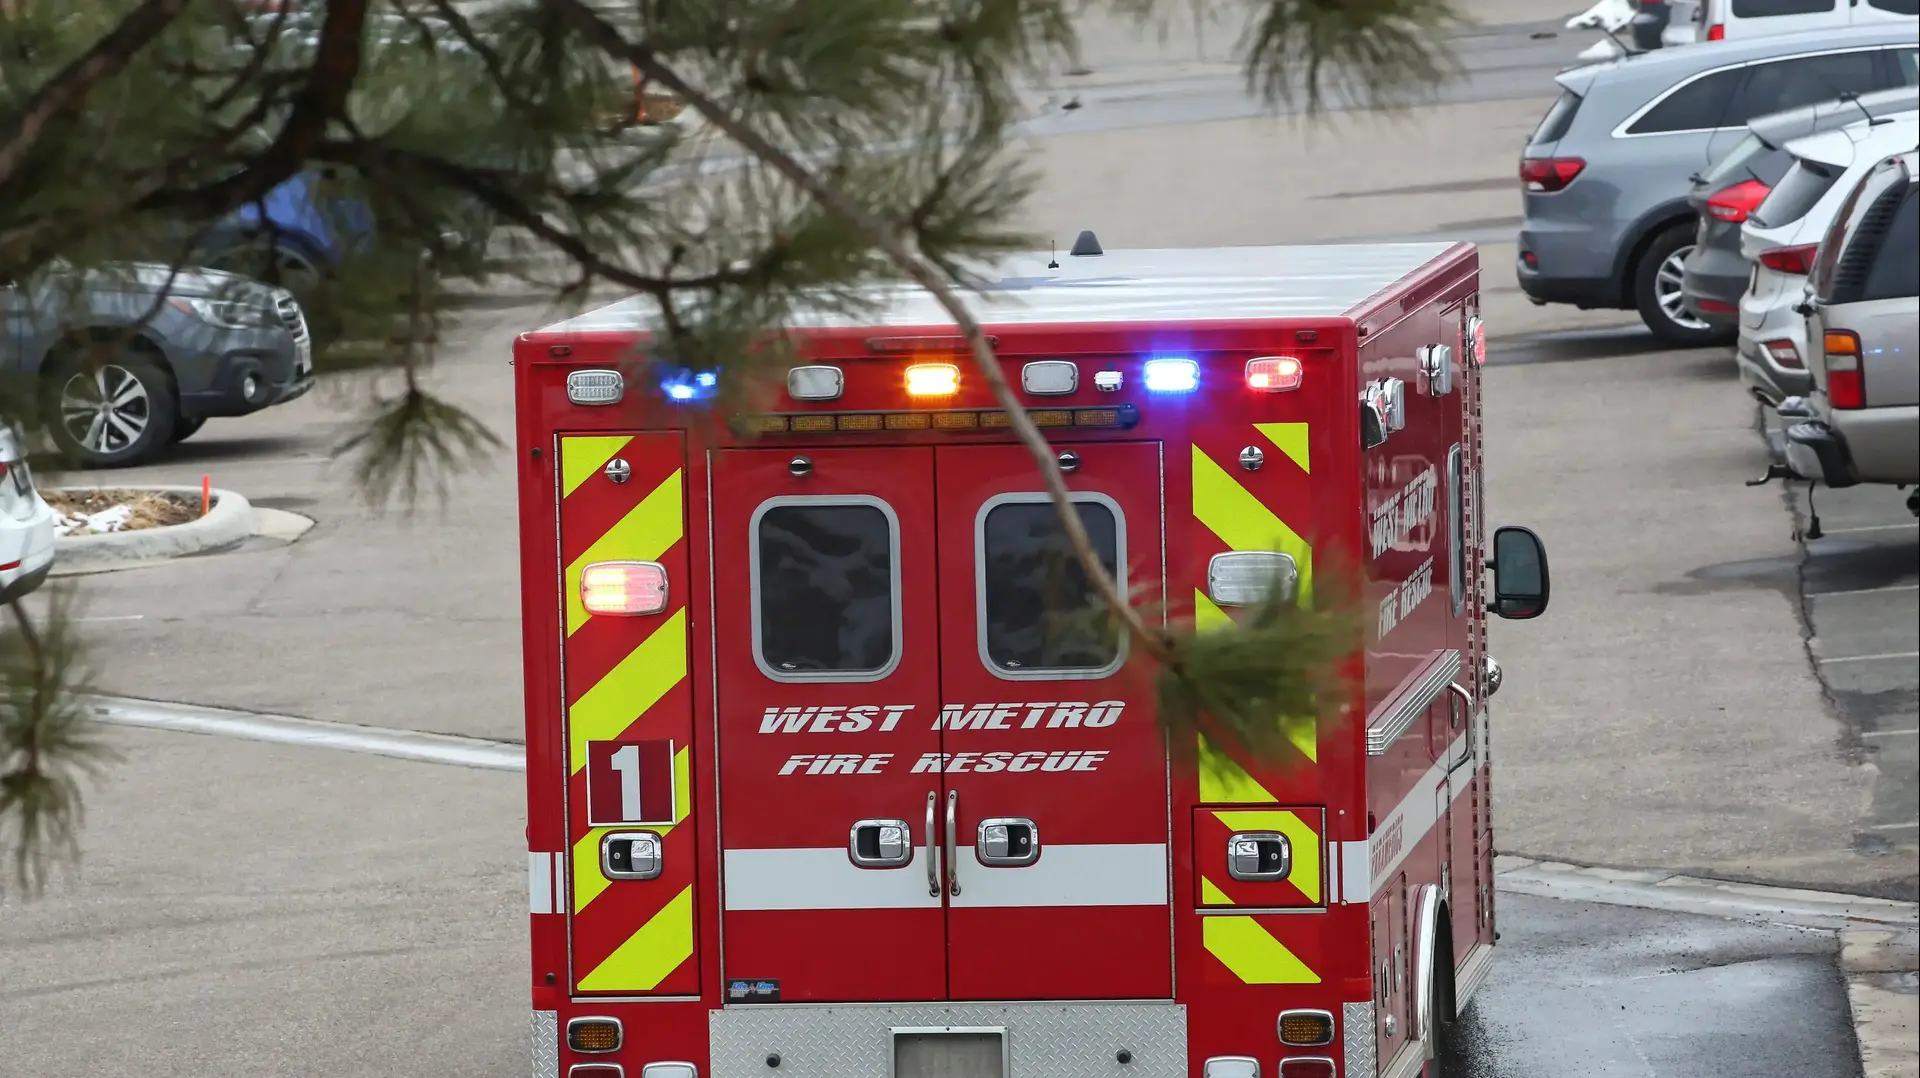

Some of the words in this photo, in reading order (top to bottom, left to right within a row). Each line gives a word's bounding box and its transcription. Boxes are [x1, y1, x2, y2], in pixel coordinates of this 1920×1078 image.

[1373, 491, 1401, 560] WEST
[758, 704, 915, 734] WEST
[931, 700, 1126, 731] METRO
[611, 745, 641, 821] 1
[778, 753, 895, 775] FIRE
[910, 750, 1110, 774] RESCUE
